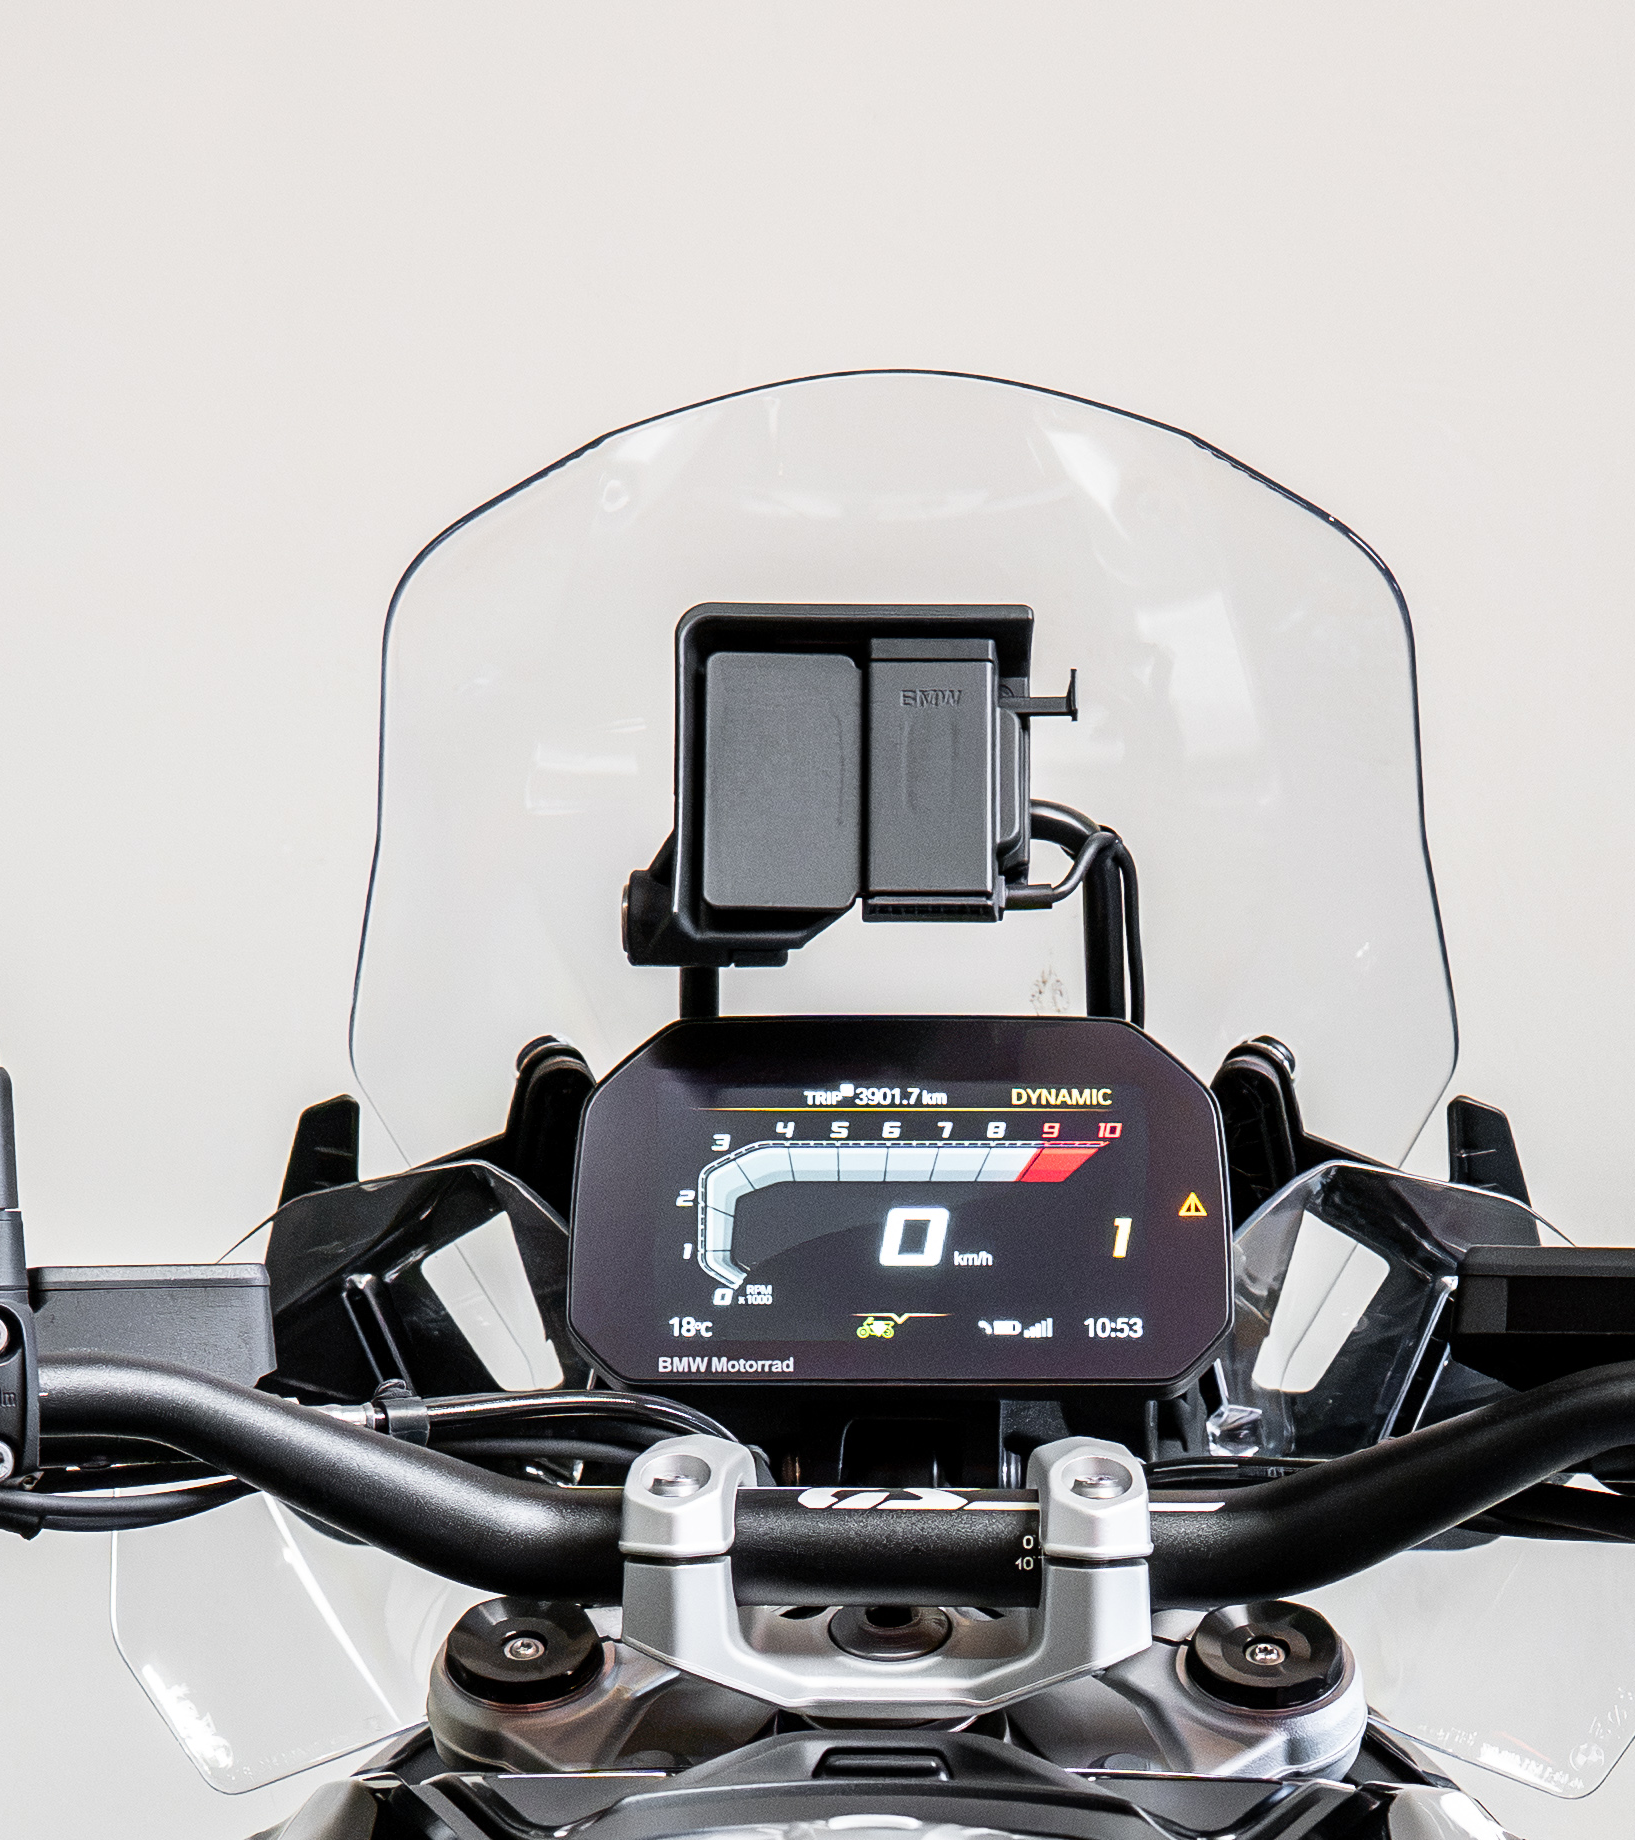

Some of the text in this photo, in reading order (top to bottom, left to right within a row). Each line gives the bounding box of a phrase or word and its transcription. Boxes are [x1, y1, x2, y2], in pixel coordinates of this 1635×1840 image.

[900, 689, 962, 706] BMW
[854, 1087, 920, 1105] 3901.7
[922, 1090, 948, 1105] km
[1011, 1088, 1112, 1106] DYNAMIC
[775, 1121, 1122, 1138] 4 5 6 7 8 9 10
[711, 1134, 731, 1151] 3
[676, 1189, 696, 1207] 2
[879, 1207, 993, 1266] 0 km/h
[1113, 1217, 1132, 1258] 1
[683, 1243, 693, 1259] 1
[713, 1288, 733, 1305] 0
[746, 1285, 772, 1295] RPM
[1084, 1317, 1143, 1338] 10:53
[658, 1356, 794, 1372] BMW Motorrad
